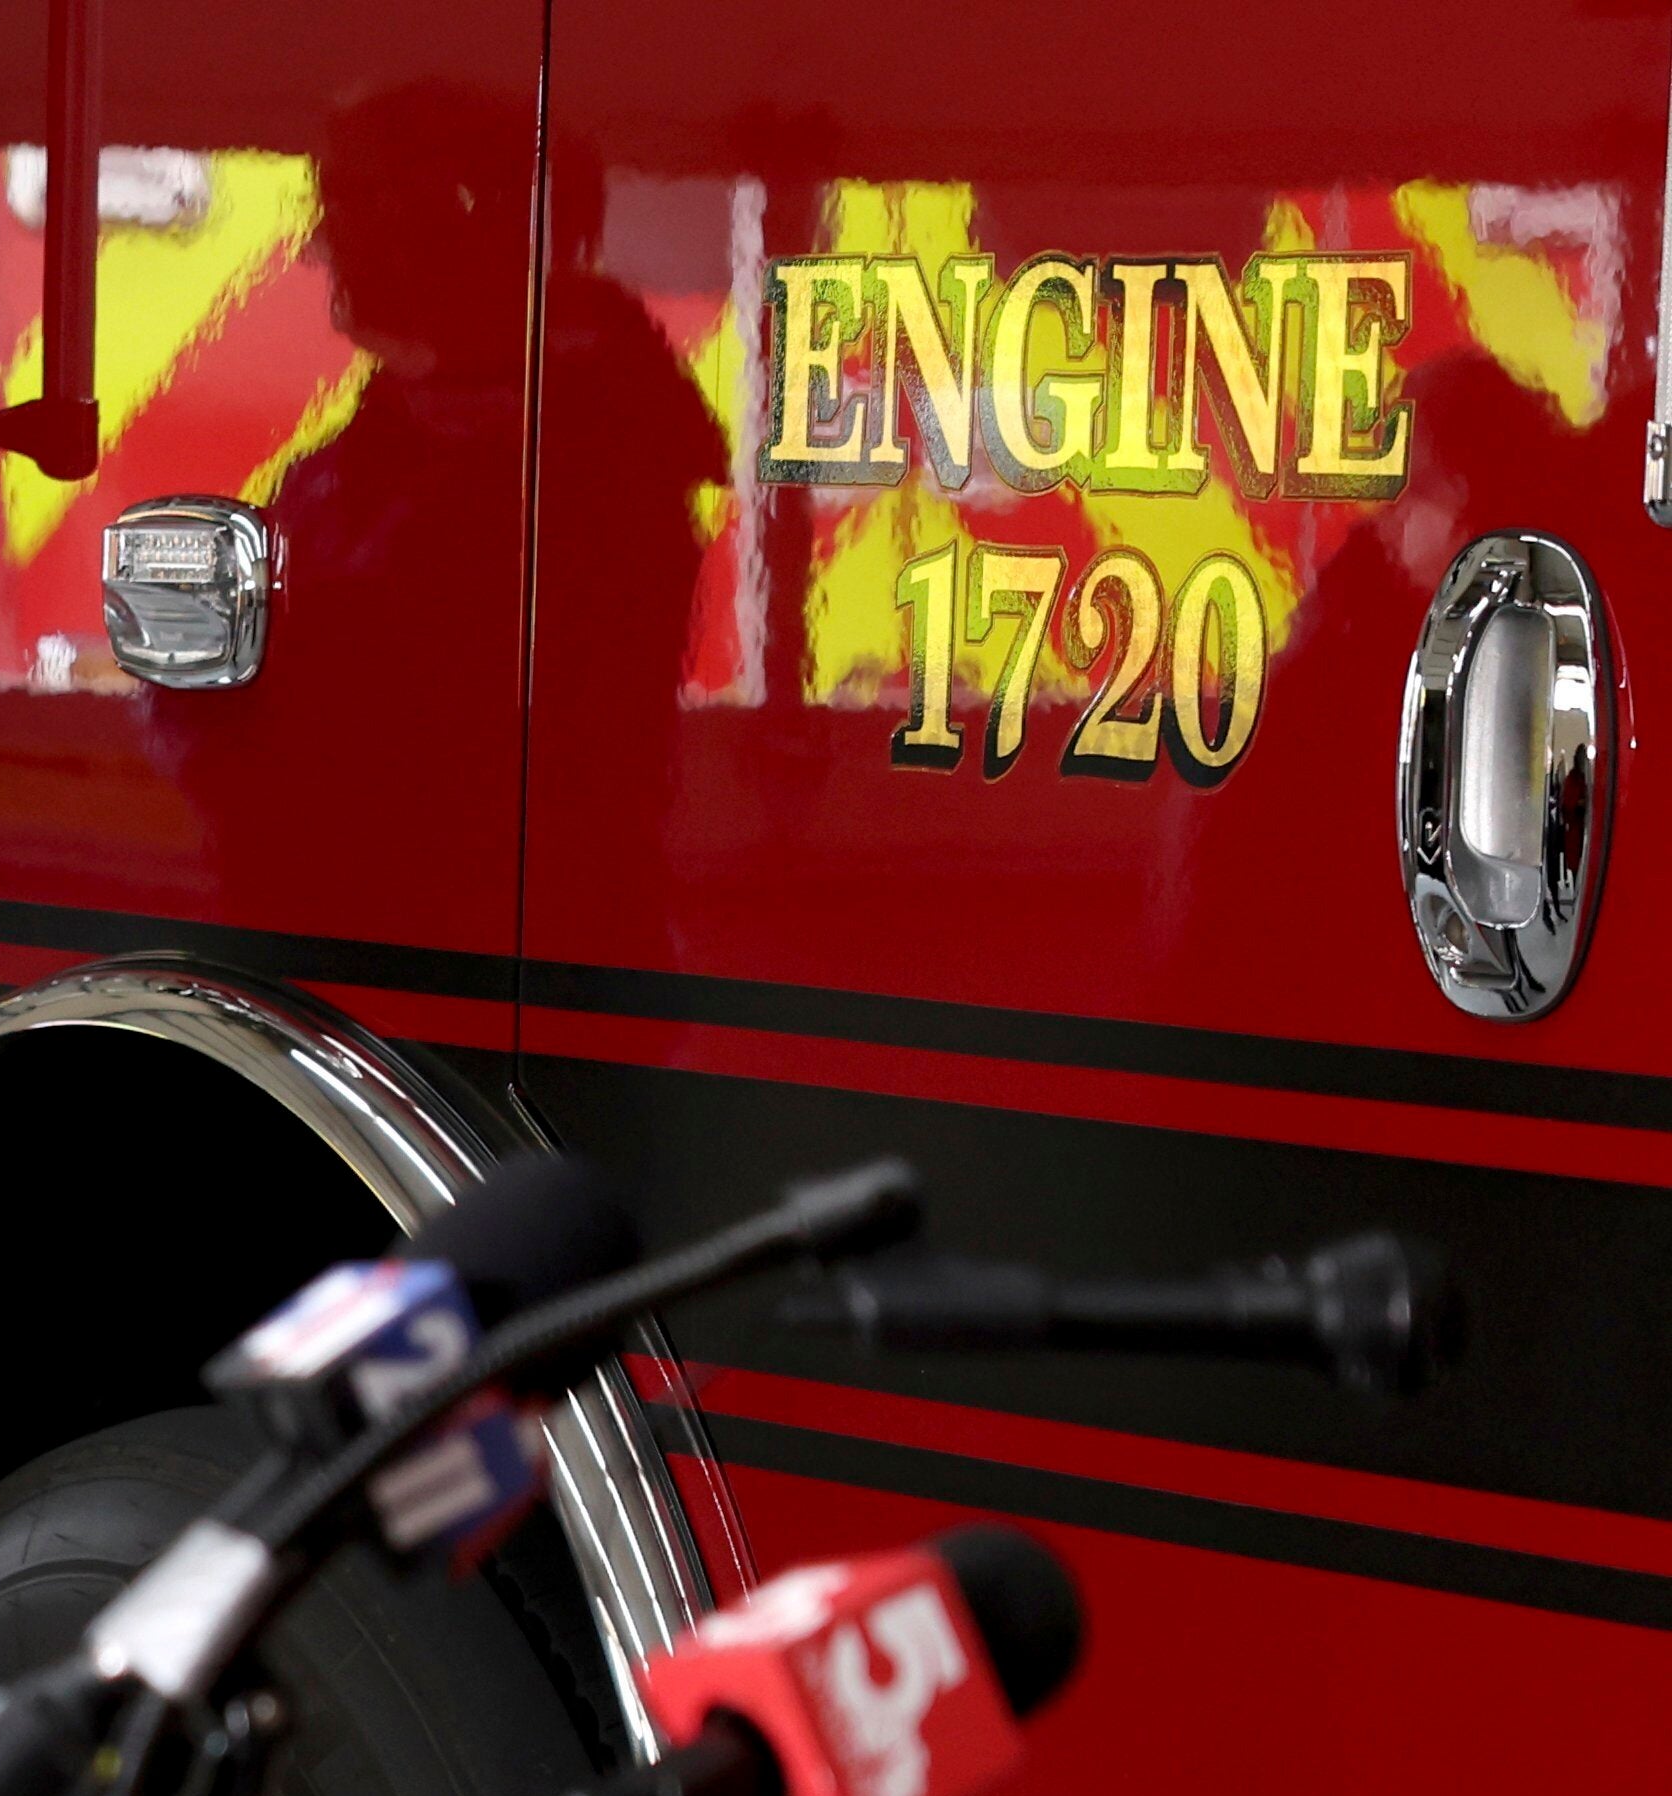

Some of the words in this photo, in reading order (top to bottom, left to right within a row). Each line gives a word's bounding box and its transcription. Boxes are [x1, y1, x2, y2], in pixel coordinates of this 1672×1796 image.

[755, 250, 1414, 504] ENGINE
[891, 543, 1271, 791] 1720
[826, 1583, 967, 1728] 5
